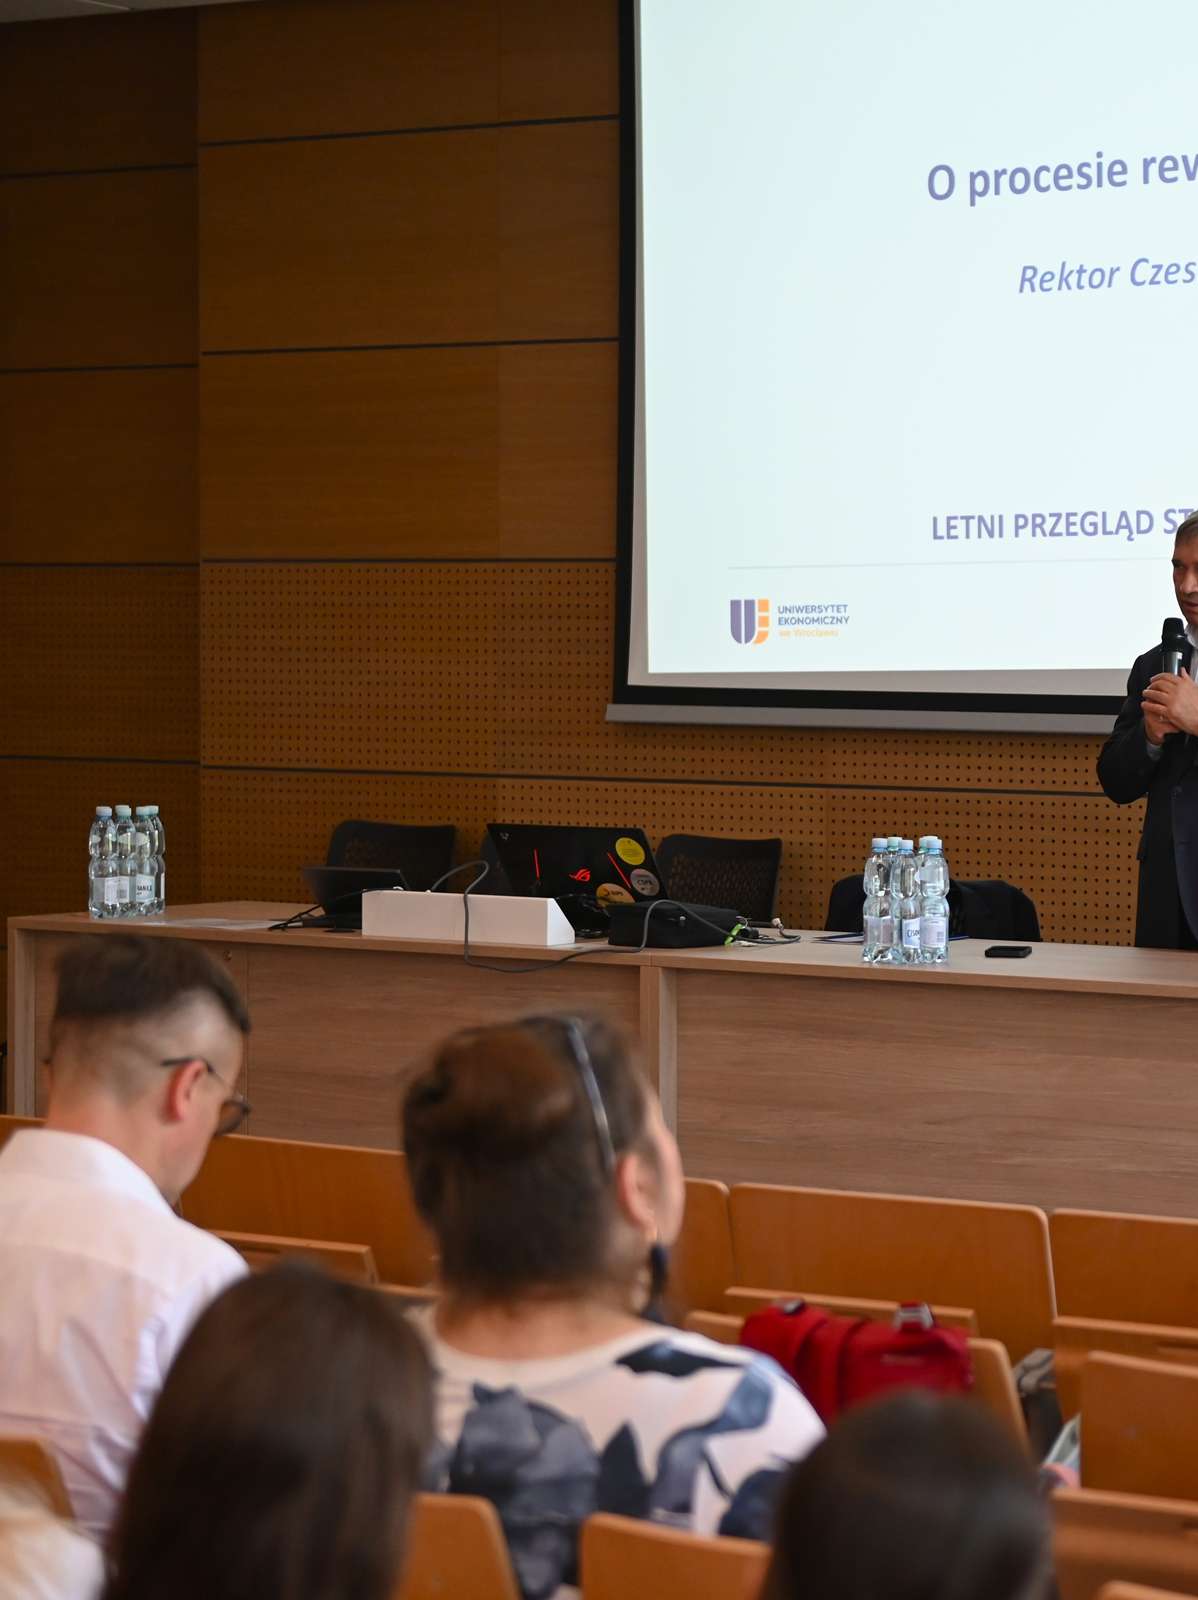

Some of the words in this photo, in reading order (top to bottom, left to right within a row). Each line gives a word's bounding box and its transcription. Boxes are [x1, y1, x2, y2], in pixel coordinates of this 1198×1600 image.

[927, 164, 956, 201] O
[968, 150, 1129, 208] procesie
[1018, 260, 1121, 294] Rektor
[932, 513, 1004, 541] LETNI
[1013, 508, 1155, 542] PRZEGLĄD
[777, 603, 849, 615] UNIWERSYTET
[777, 615, 850, 626] EKONOMICZNY
